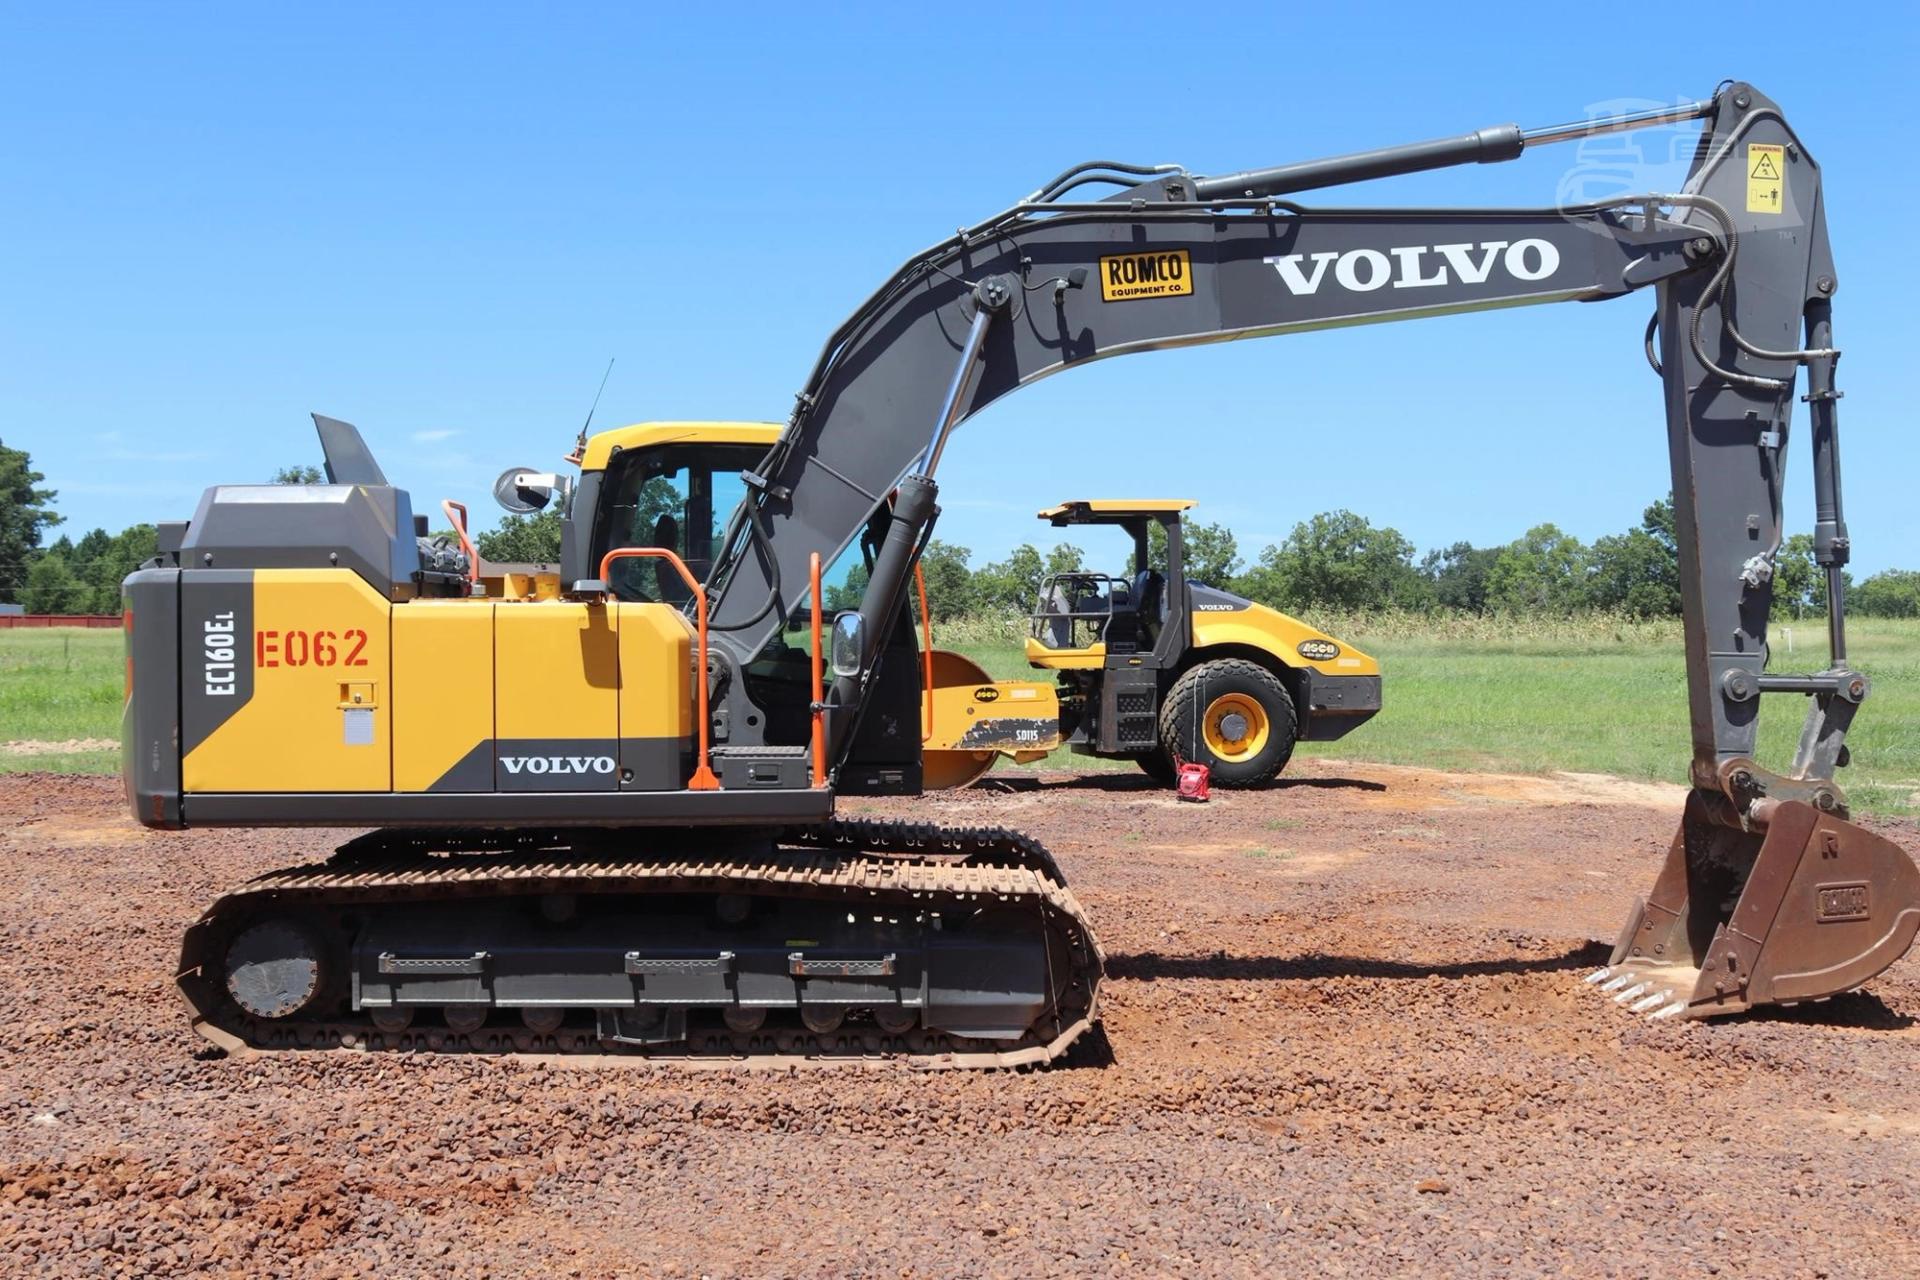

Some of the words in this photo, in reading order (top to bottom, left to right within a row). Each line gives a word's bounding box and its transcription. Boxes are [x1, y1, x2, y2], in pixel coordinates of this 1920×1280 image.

[1108, 254, 1183, 285] ROMCO
[1263, 238, 1560, 295] VOLVO
[1111, 286, 1166, 297] EQUIPMENT
[1168, 284, 1184, 292] CO.
[204, 611, 235, 695] EC160EL
[256, 630, 368, 667] E062
[1016, 729, 1039, 741] SD115
[499, 756, 615, 774] VOLVO
